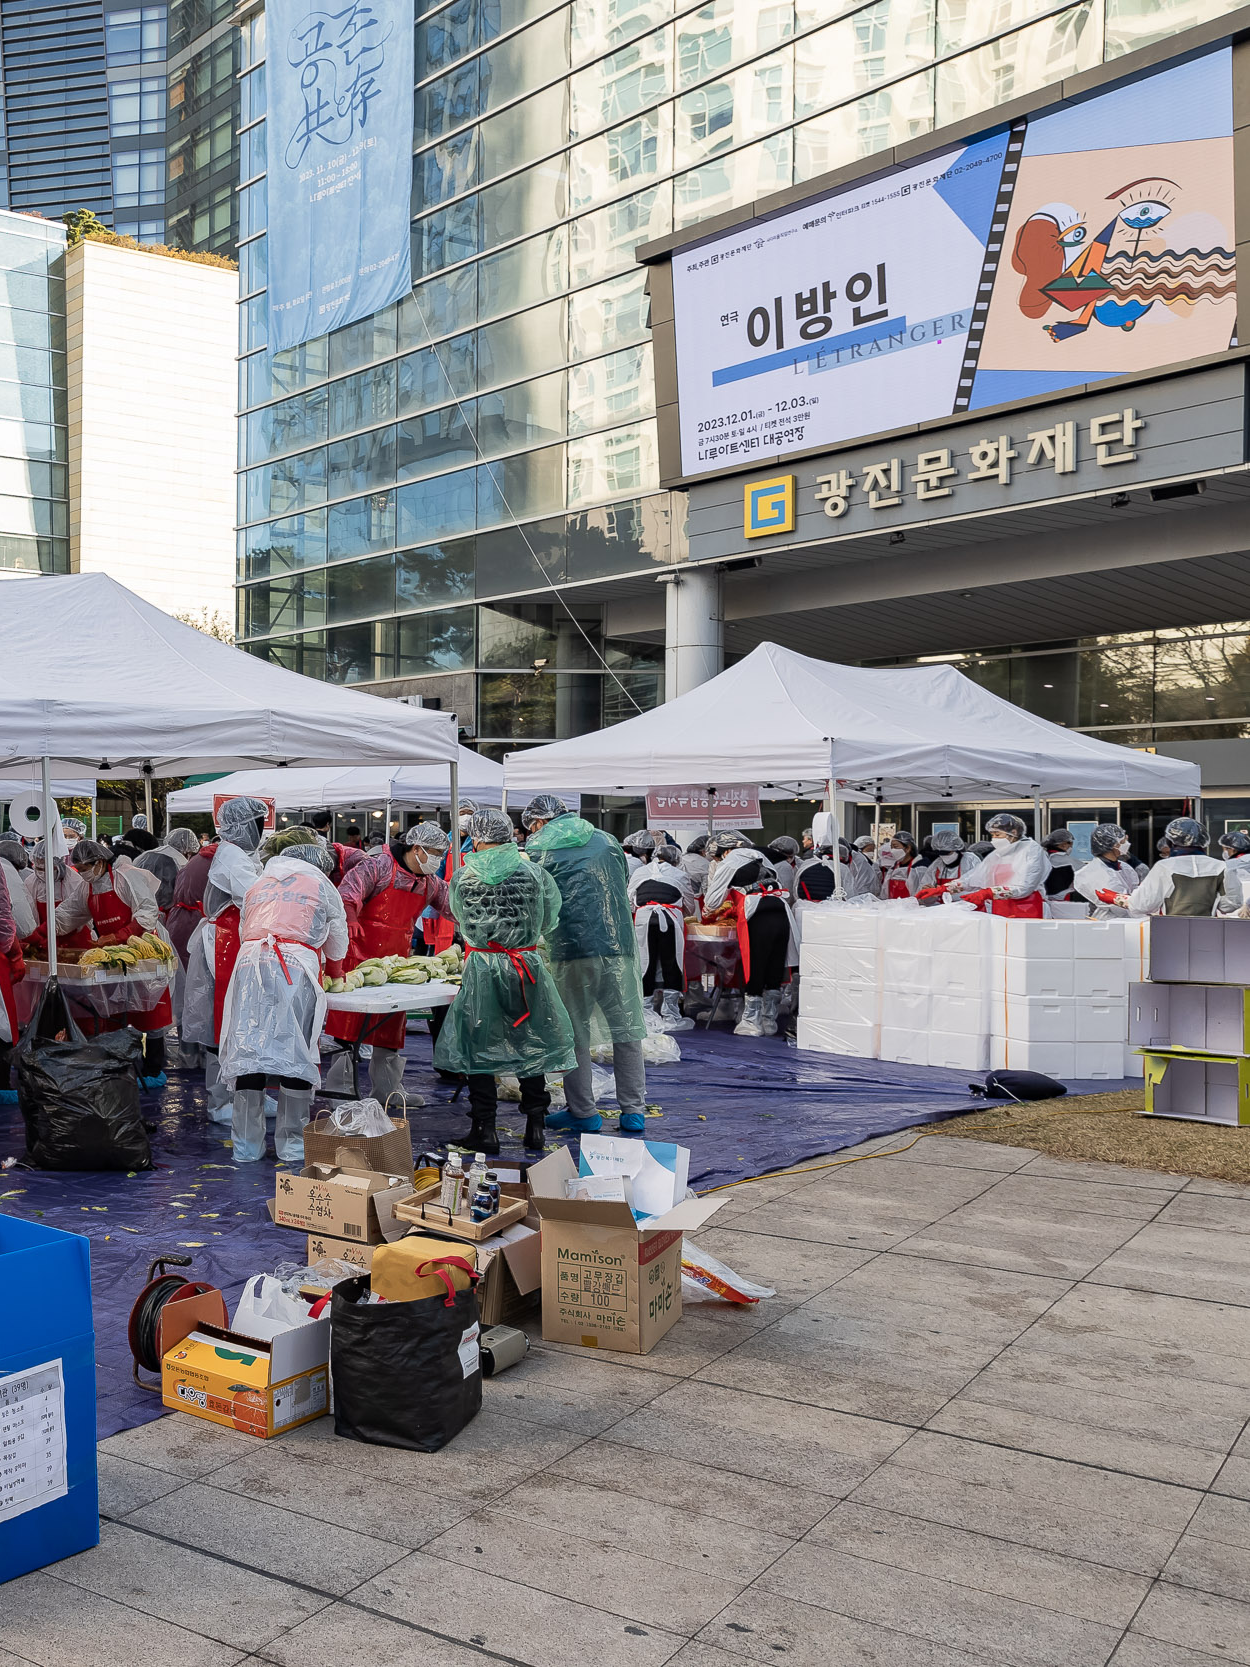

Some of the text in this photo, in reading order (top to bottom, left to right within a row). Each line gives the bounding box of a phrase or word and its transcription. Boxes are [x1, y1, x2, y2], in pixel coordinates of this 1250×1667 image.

[317, 173, 336, 188] 11:00
[802, 215, 827, 230] 예매문의
[871, 191, 901, 206] 1544-1555
[912, 171, 953, 191] 광진문화재단
[954, 151, 1003, 175] 02-2049-4700
[747, 262, 889, 350] 이방인
[720, 311, 739, 327] 연극
[793, 314, 966, 375] L'ÉTRANGER
[698, 438, 705, 447] 금
[746, 424, 757, 434] 4시
[764, 418, 777, 430] 티켓
[778, 415, 791, 426] 전석
[792, 411, 811, 423] 3만원
[698, 426, 805, 461] 나루아트센터 대공연장
[814, 407, 1145, 518] 광진문화재단
[307, 1189, 333, 1206] 옥수수
[307, 1204, 331, 1219] 수염차
[557, 1248, 622, 1266] Mamison
[583, 1270, 623, 1285] 고무장갑
[591, 1294, 610, 1307] 100
[649, 1282, 672, 1322] 마미손
[559, 1308, 626, 1327] 주식회사 마미손
[11, 1380, 29, 1394] (39명)
[46, 1451, 52, 1459] 35
[46, 1465, 53, 1473] 39
